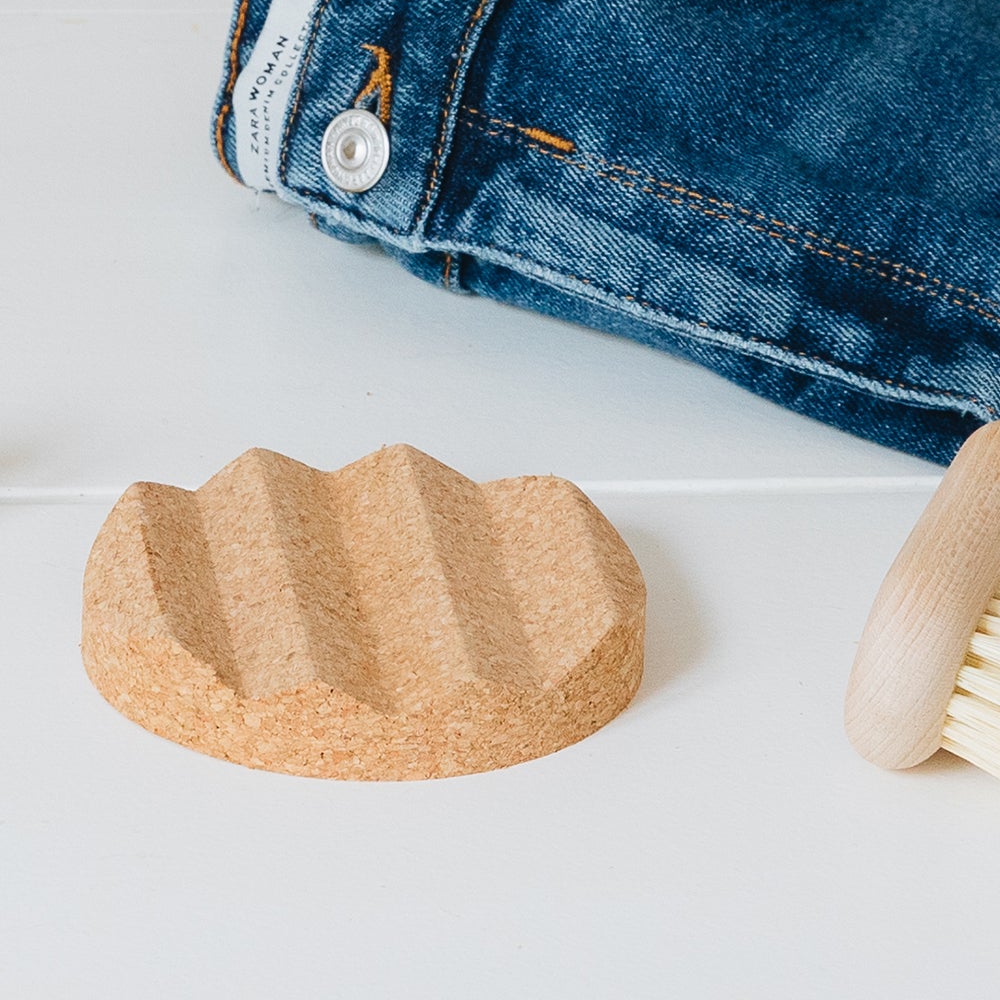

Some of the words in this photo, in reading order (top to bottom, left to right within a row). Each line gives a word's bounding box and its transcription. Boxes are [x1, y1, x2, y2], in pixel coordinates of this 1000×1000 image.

[249, 35, 289, 101] WOMAN
[249, 108, 261, 155] ZARA
[263, 90, 275, 131] DENIM
